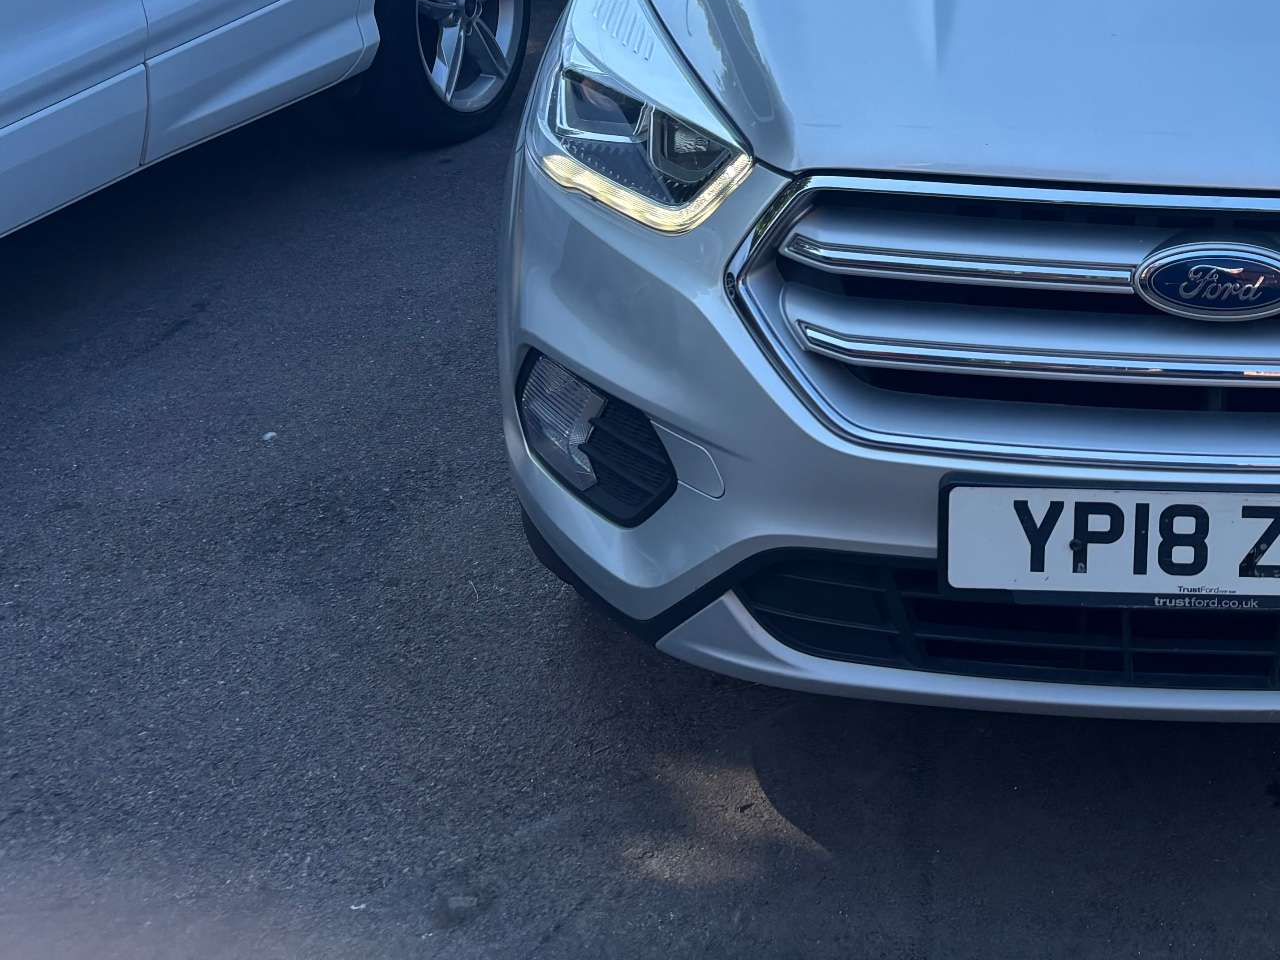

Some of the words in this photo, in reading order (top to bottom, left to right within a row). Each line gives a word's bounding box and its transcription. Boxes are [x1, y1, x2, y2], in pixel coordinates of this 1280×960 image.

[1178, 263, 1265, 301] Ford
[1013, 499, 1210, 575] YP18
[1178, 585, 1219, 594] TrustFord
[1154, 596, 1258, 609] trustford.co.uk
